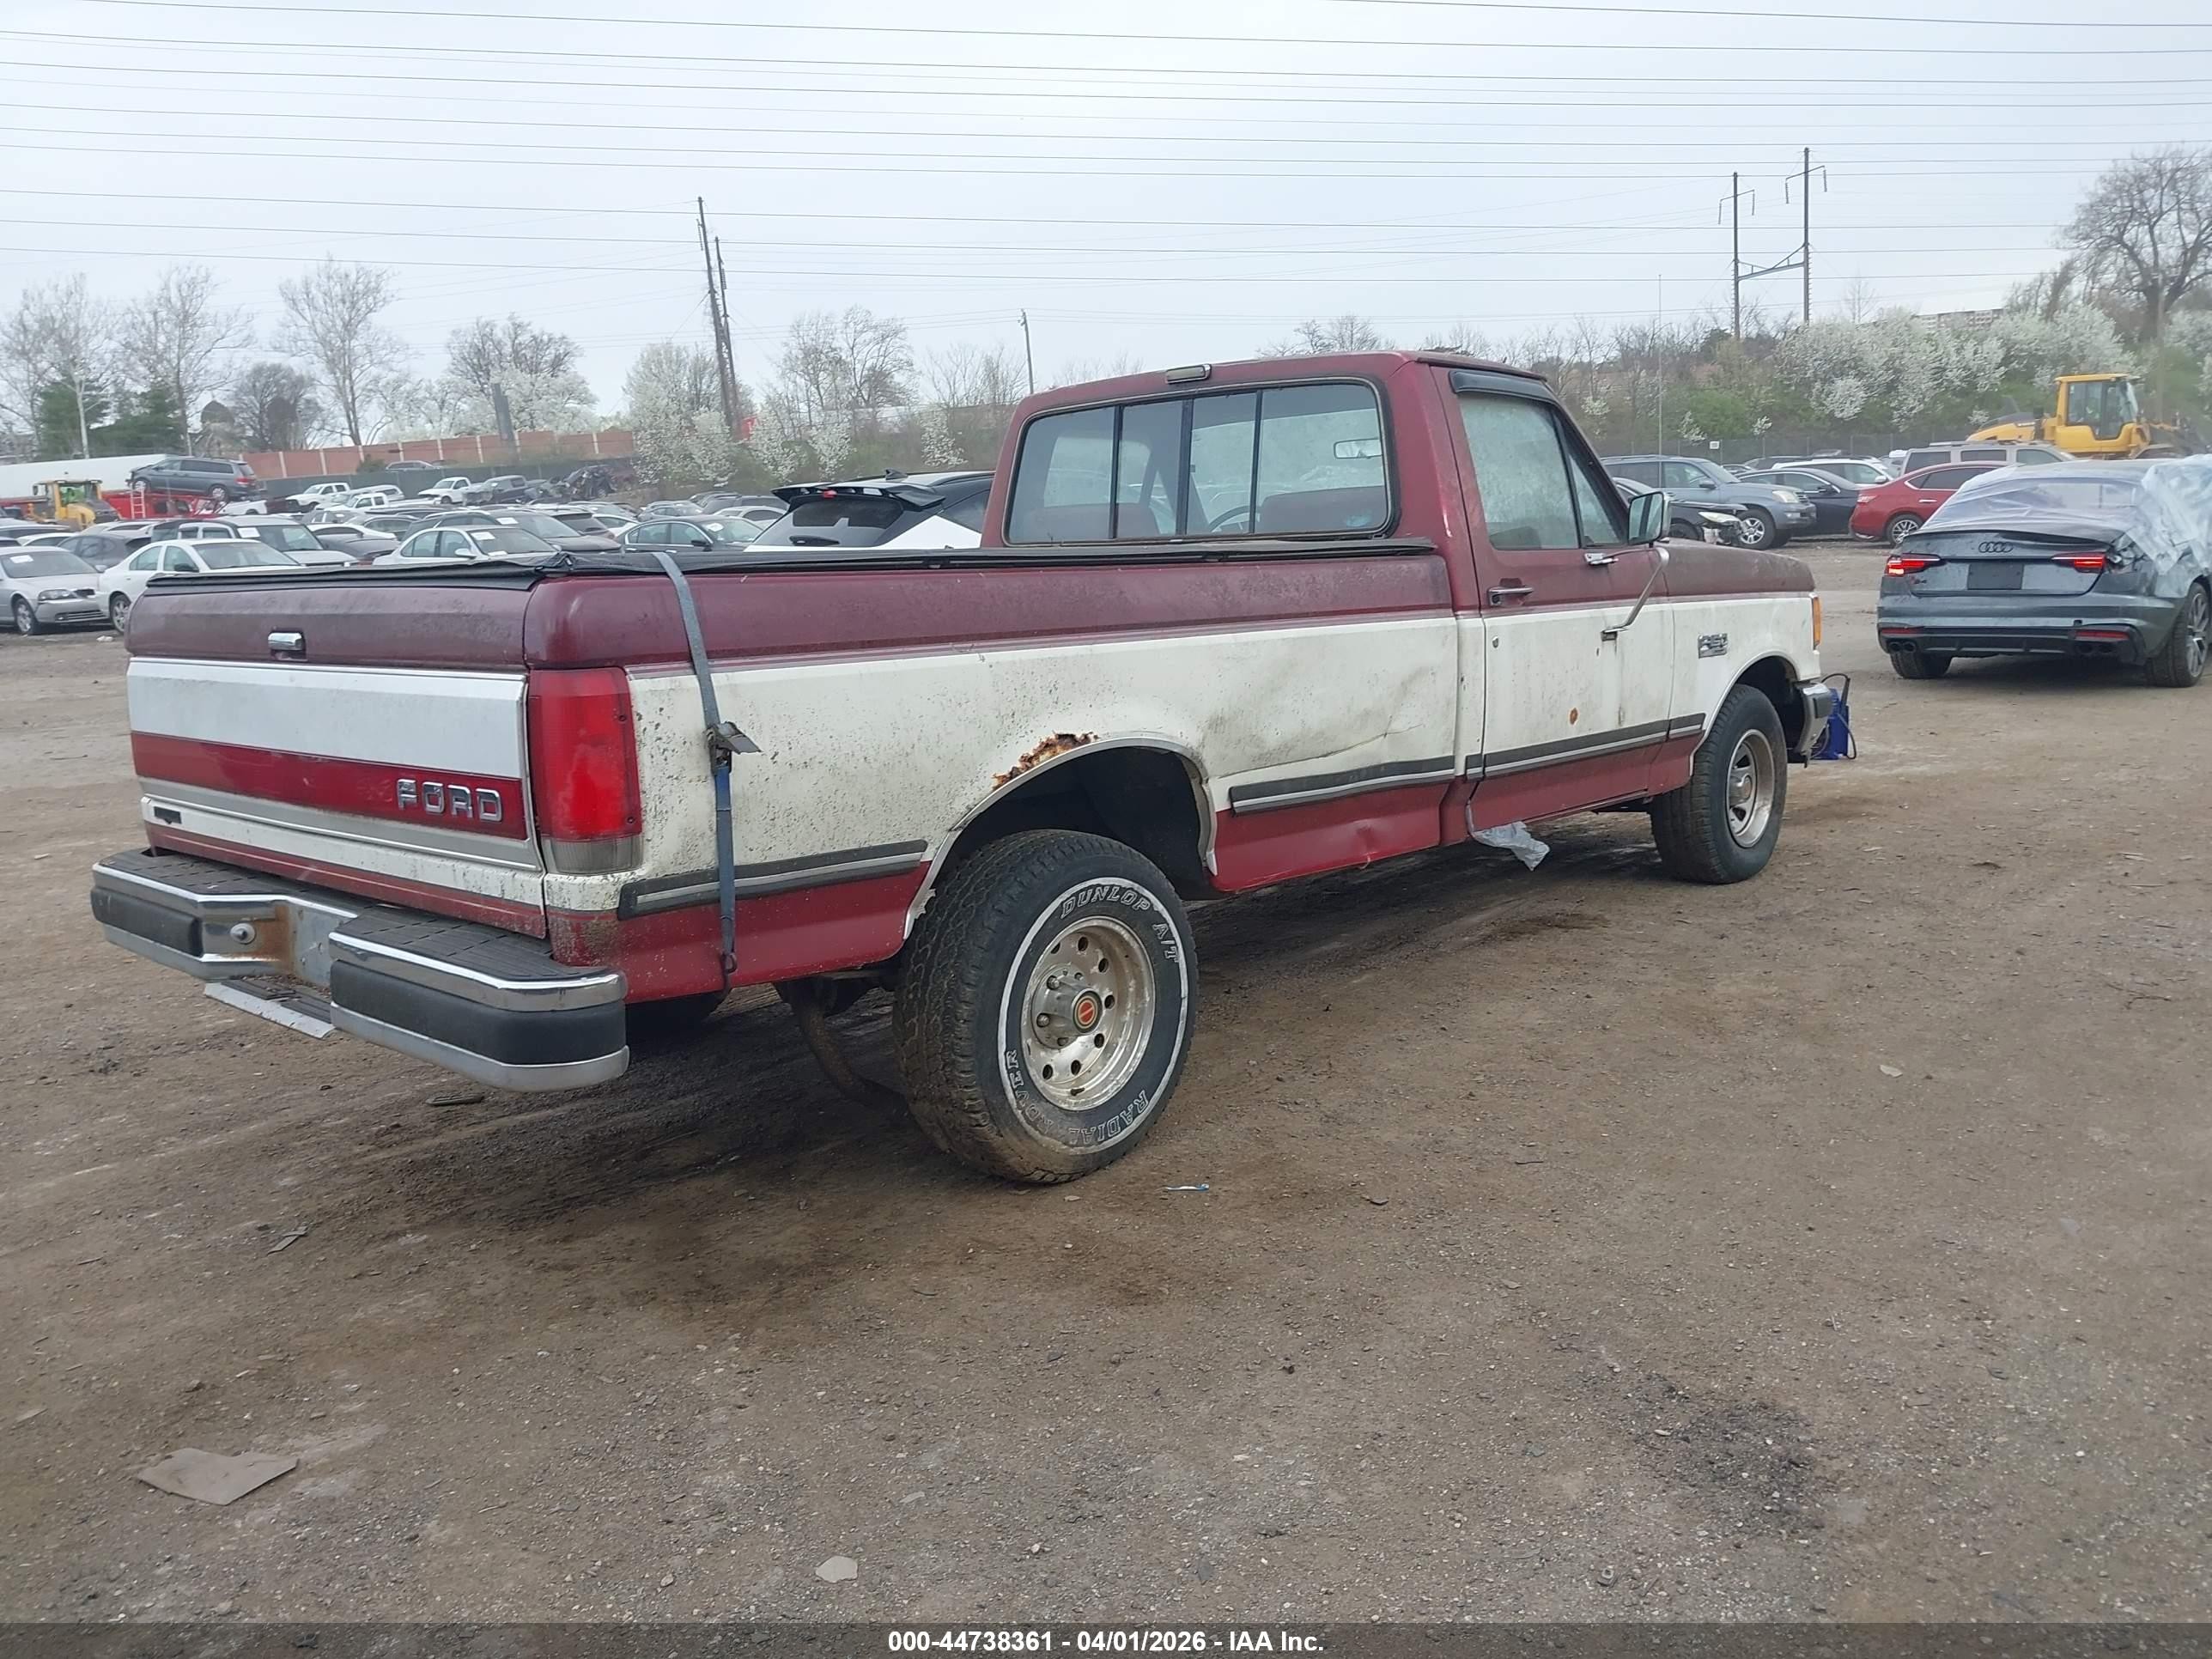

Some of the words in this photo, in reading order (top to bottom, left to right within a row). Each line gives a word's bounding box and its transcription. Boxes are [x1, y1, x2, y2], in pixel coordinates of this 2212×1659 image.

[397, 778, 504, 823] FORD
[1060, 884, 1152, 920] DUNLOP
[1152, 922, 1181, 963] A/T
[1069, 1089, 1150, 1146] RADIAL
